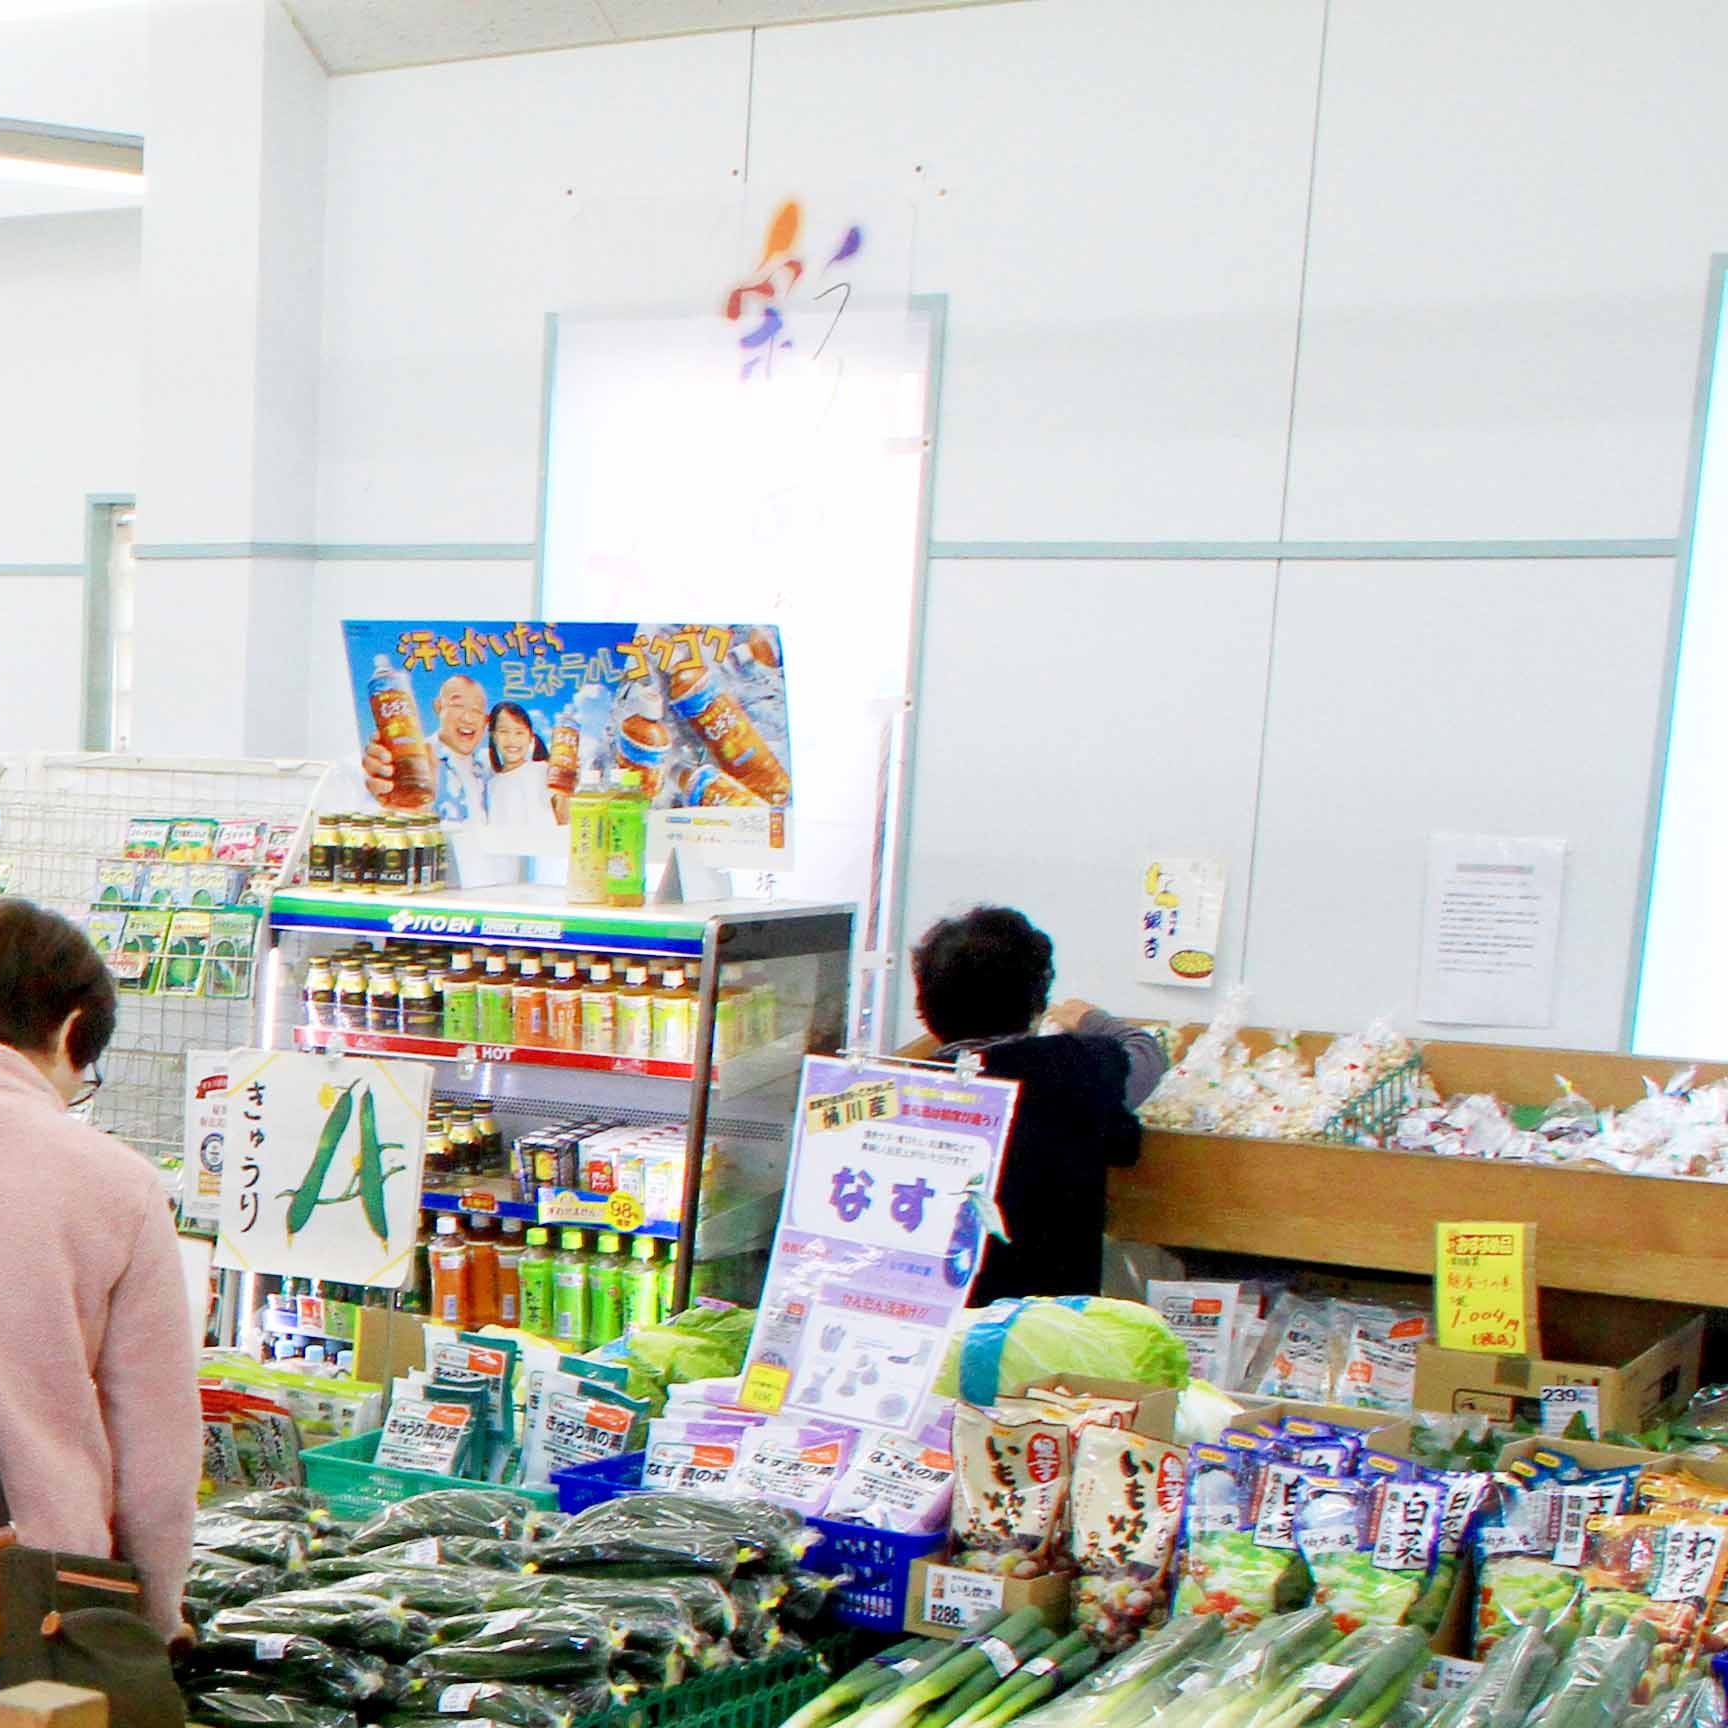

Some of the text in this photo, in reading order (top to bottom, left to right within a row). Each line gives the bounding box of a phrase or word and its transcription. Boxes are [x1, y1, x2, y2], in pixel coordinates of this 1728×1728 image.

[396, 621, 565, 672] 汗をかいたら
[616, 625, 737, 682] ゴクゴク
[500, 647, 624, 699] ミネラル
[411, 913, 447, 933] ITO
[447, 916, 474, 935] EN
[481, 1047, 513, 1063] HOT
[820, 1098, 888, 1130] 桶川産
[239, 1081, 267, 1234] きゅうり
[829, 1166, 936, 1233] なす
[1543, 1387, 1578, 1403] 239
[386, 1417, 459, 1442] きゅうり漬の素
[544, 1413, 623, 1451] きゅうり漬の素
[1400, 1490, 1430, 1566] 白菜
